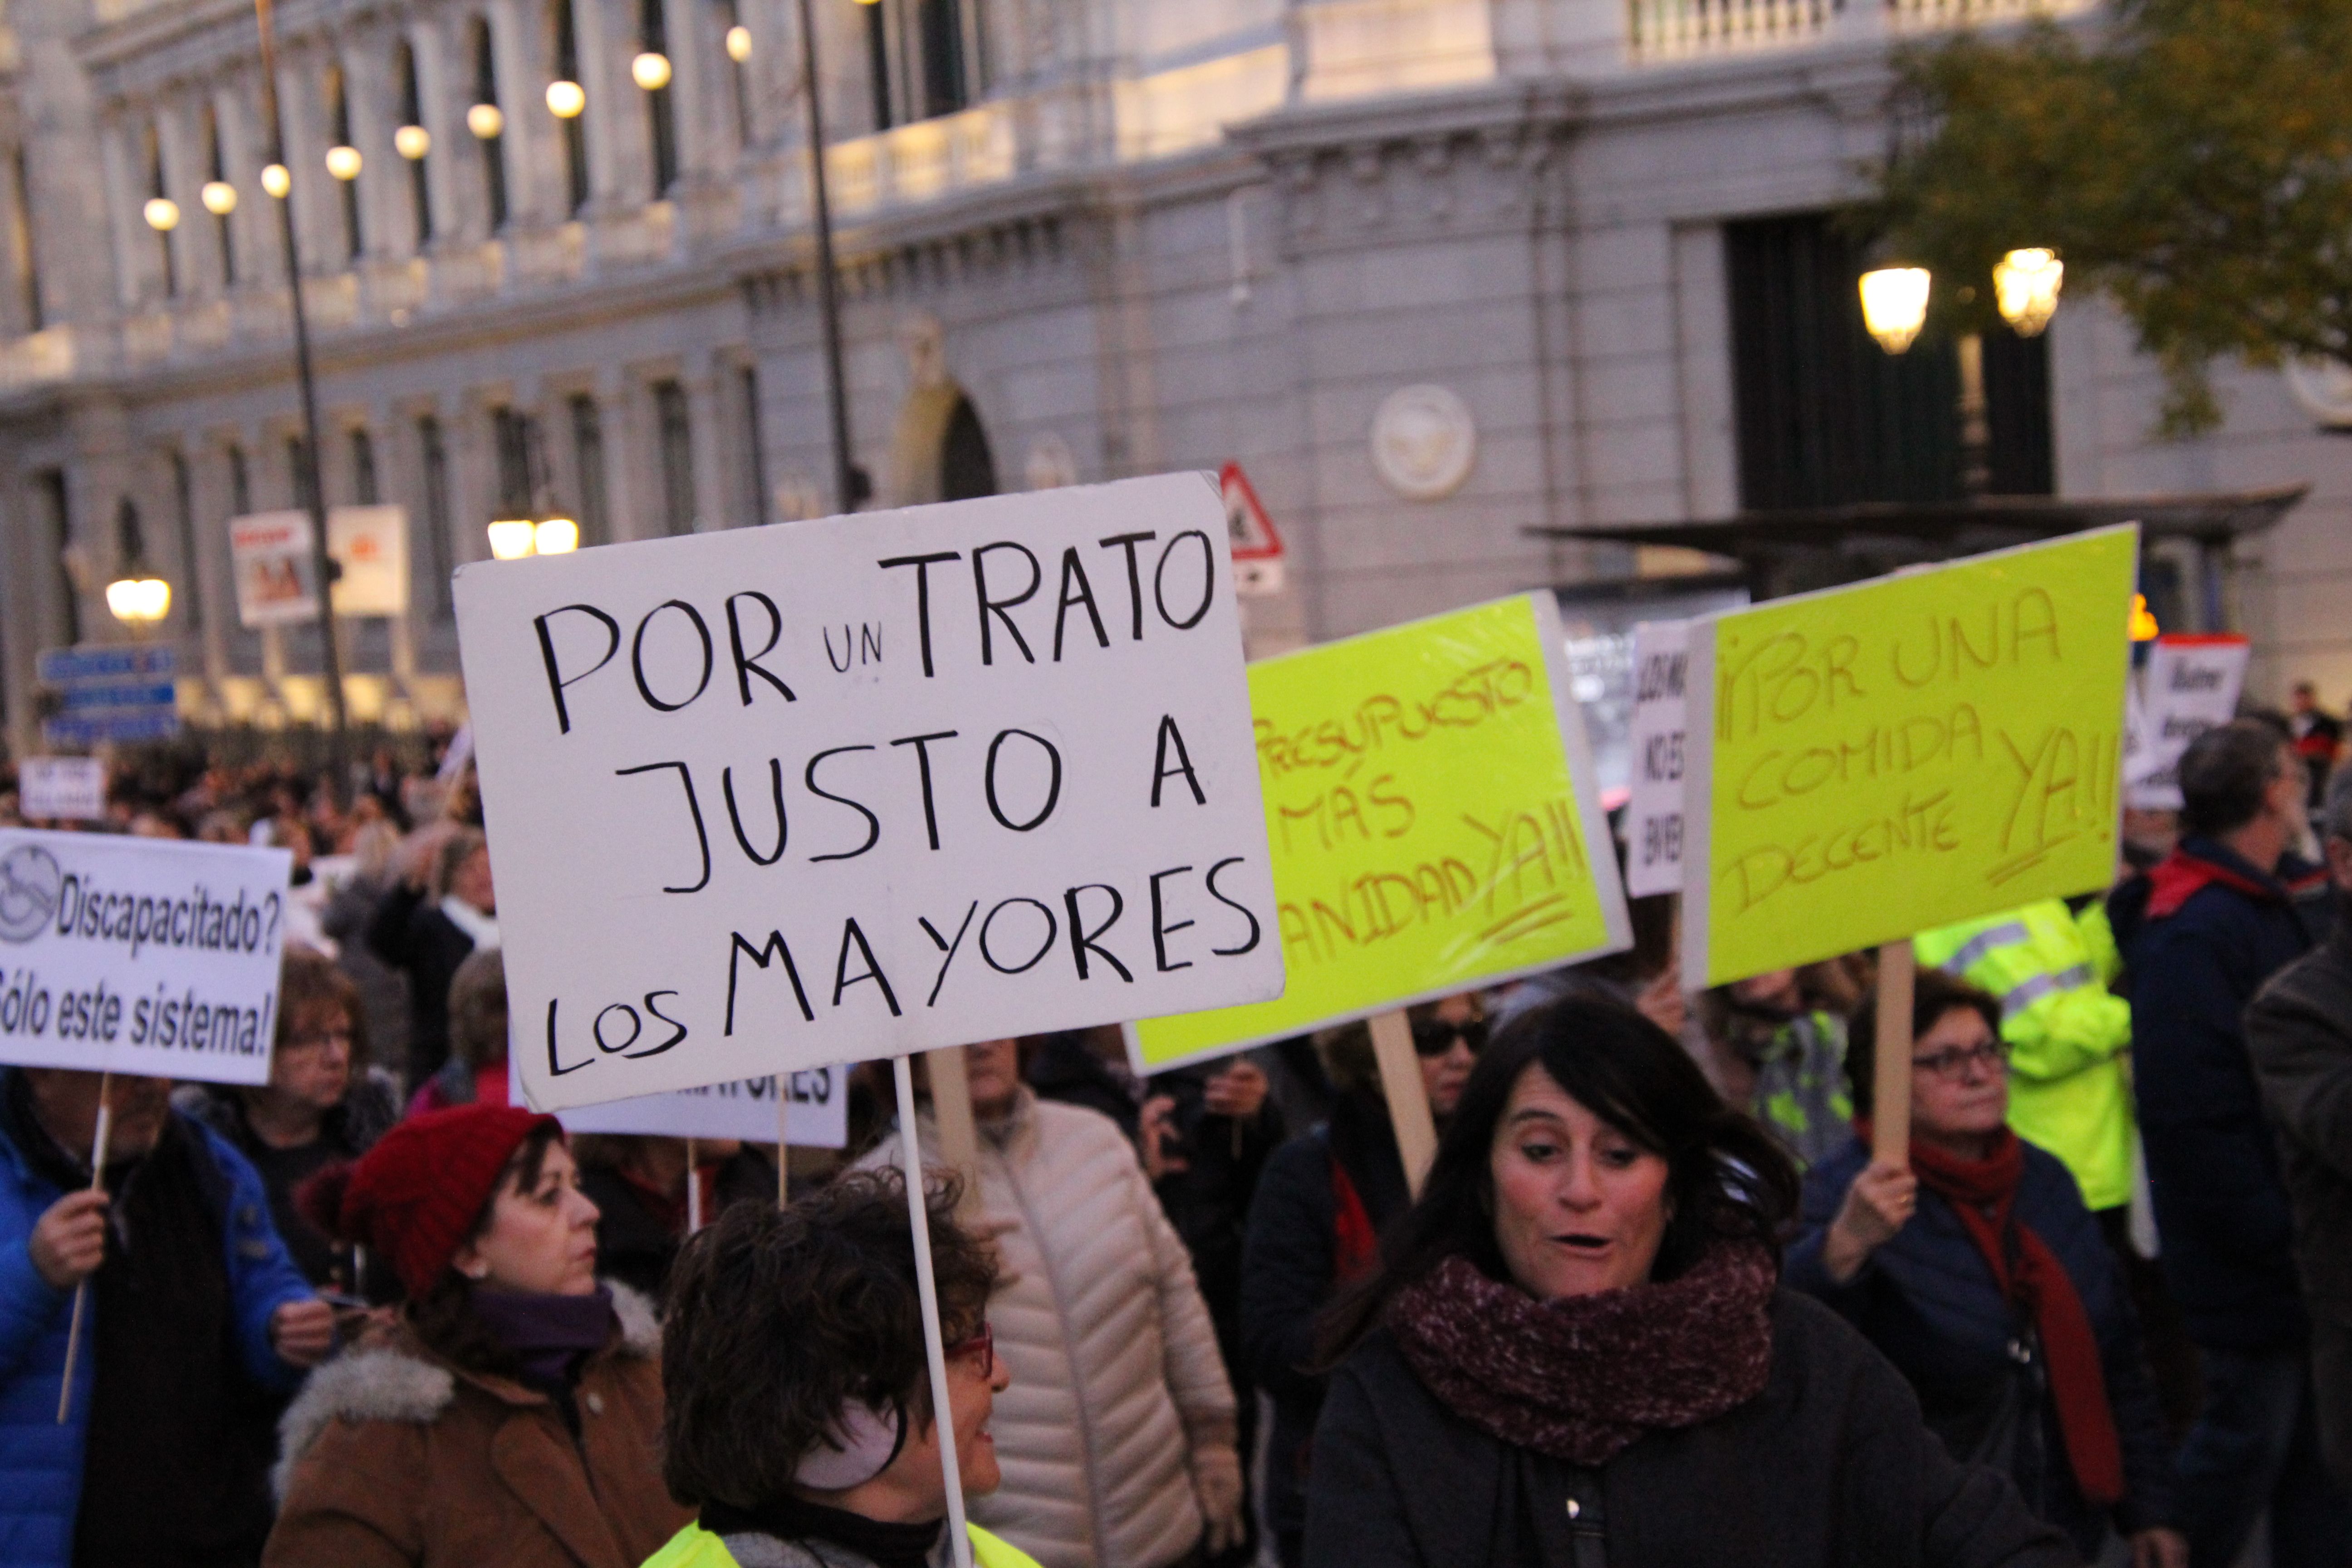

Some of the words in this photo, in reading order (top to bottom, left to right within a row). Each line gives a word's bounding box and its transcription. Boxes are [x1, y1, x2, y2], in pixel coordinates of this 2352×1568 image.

[534, 592, 797, 734] POR
[823, 622, 881, 673] UN
[877, 529, 1215, 677] TRATO
[1891, 587, 2061, 689] UNA
[616, 729, 1062, 893] JUSTO
[1150, 714, 1207, 808] A
[1738, 701, 1984, 810] COMIDA
[1717, 789, 1962, 911] DECENTE
[1998, 725, 2119, 855] YA!!
[57, 873, 280, 960] Discapacitado?
[547, 990, 688, 1077] LOS
[725, 857, 1260, 1037] MAYORES
[1277, 858, 1477, 970] ANIDAD
[0, 967, 49, 1037] ólo
[58, 978, 120, 1042] este
[131, 980, 272, 1057] sistema!
